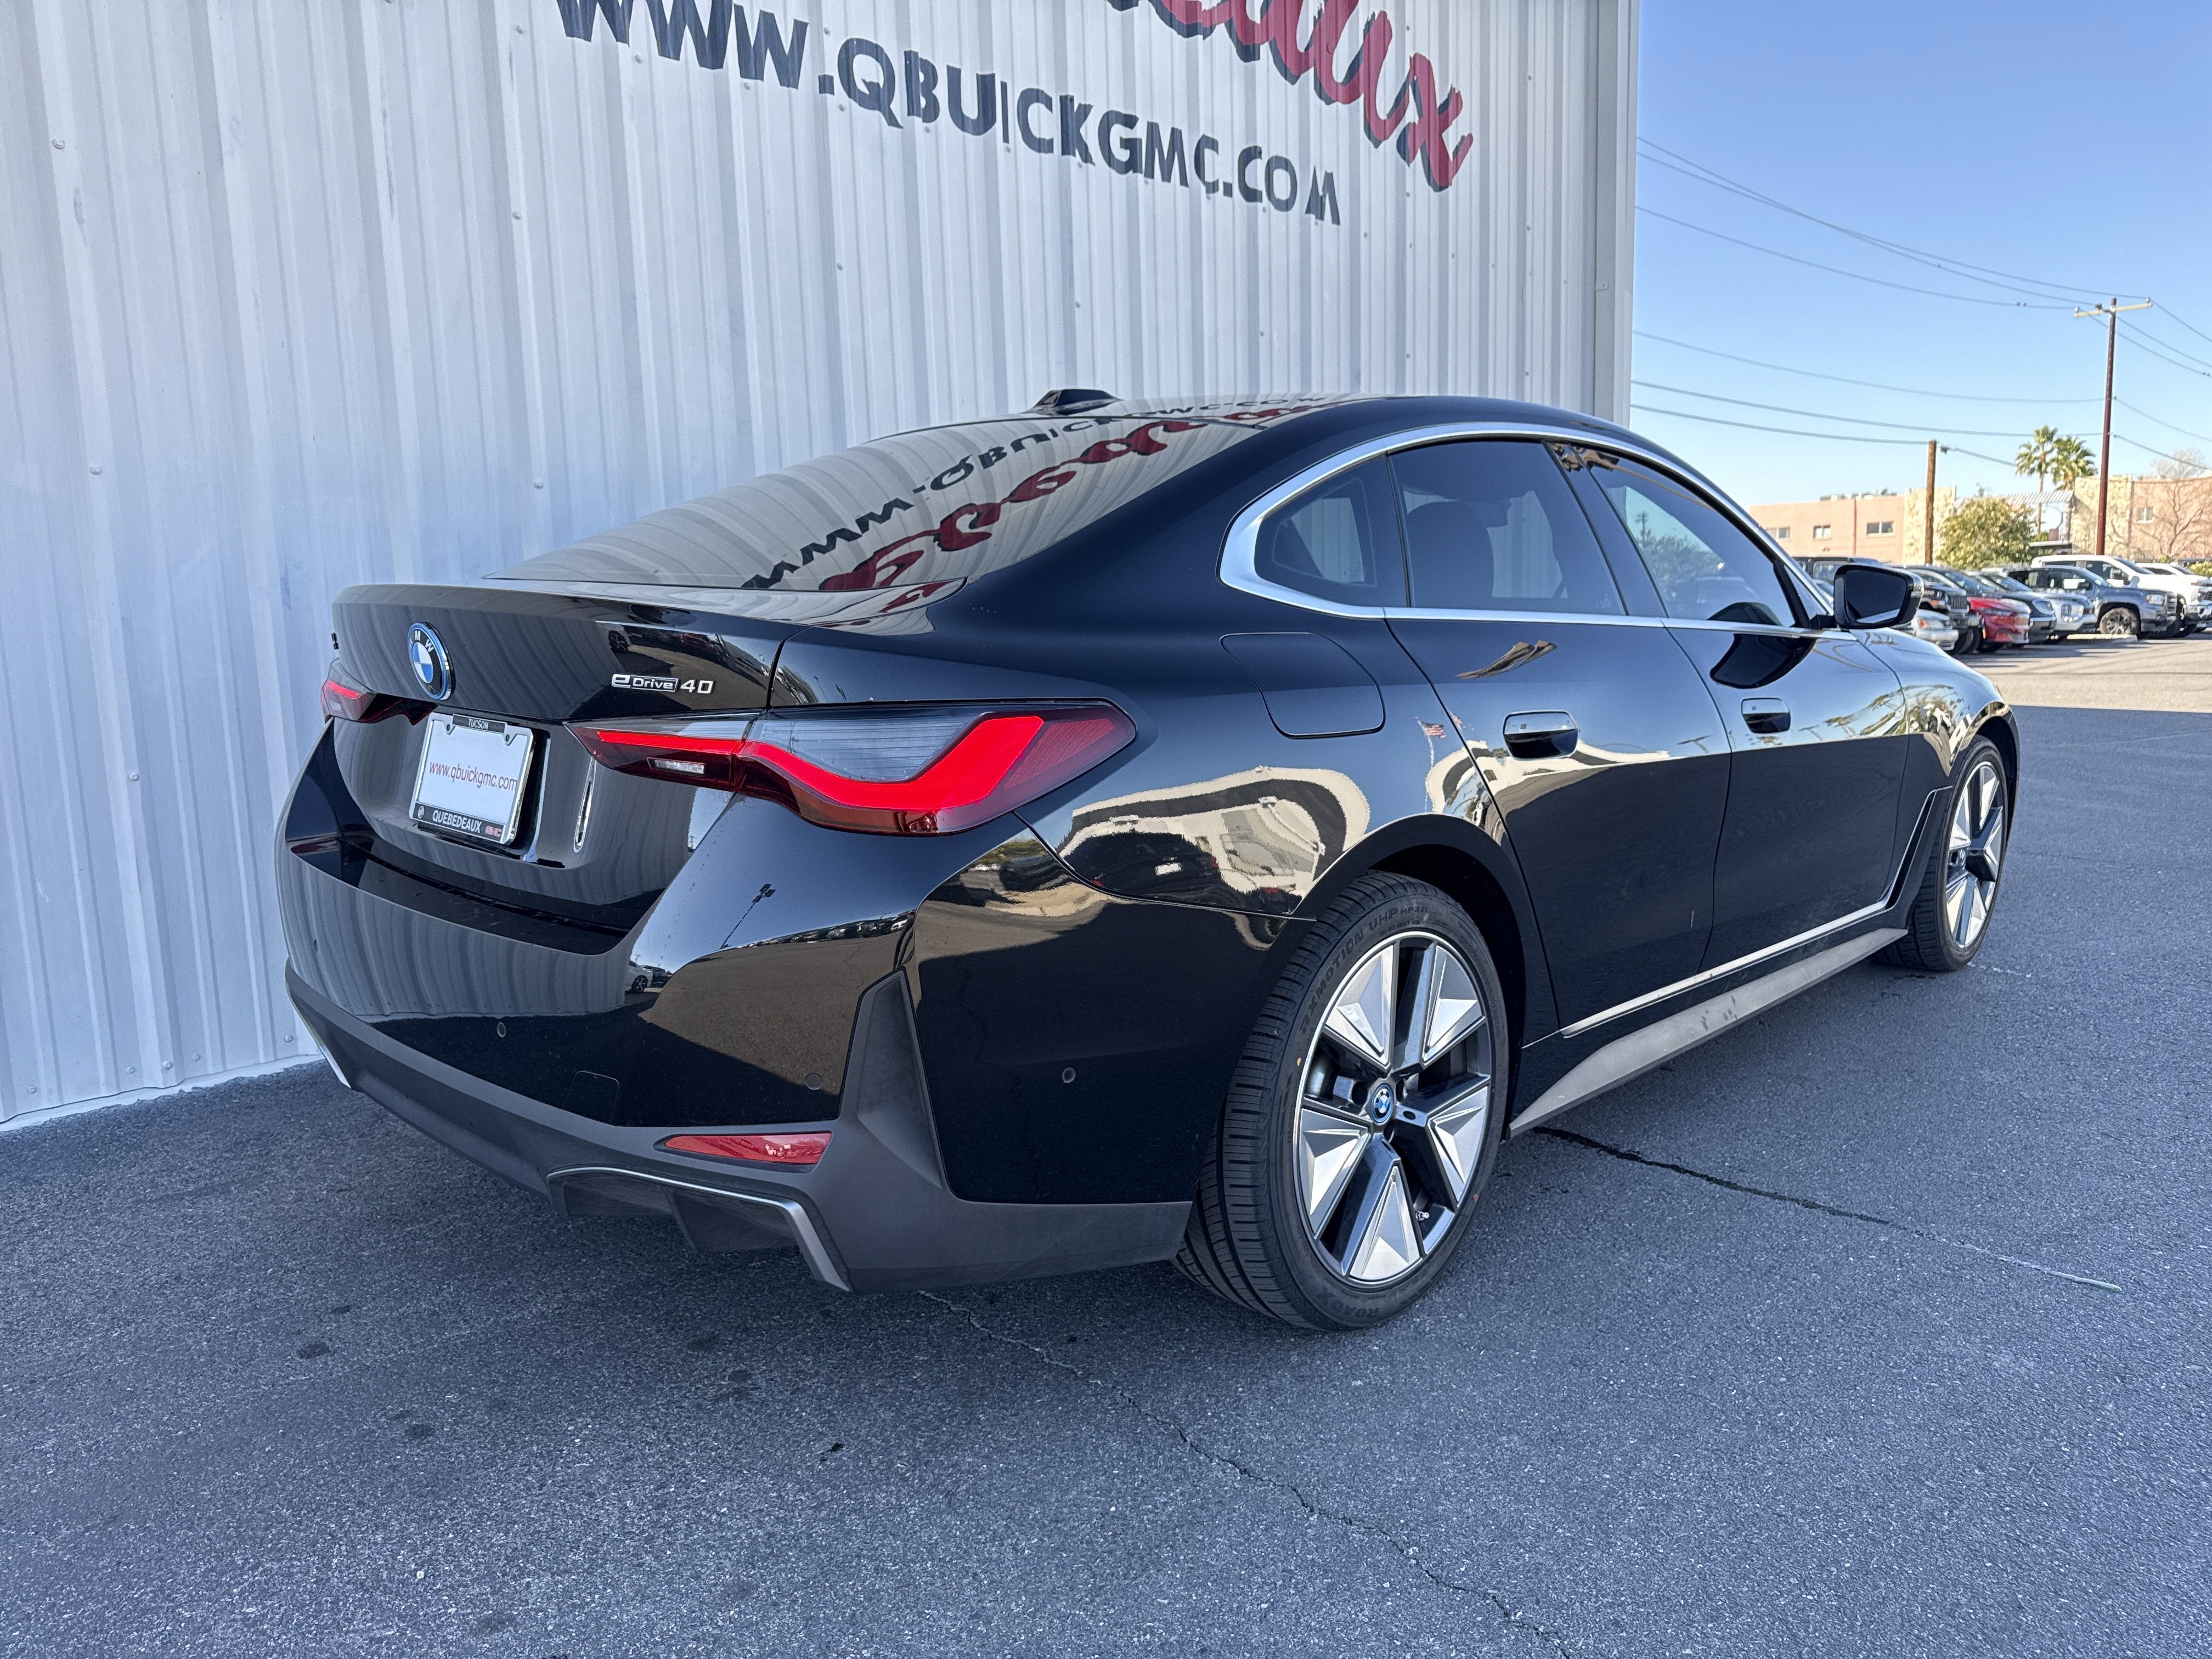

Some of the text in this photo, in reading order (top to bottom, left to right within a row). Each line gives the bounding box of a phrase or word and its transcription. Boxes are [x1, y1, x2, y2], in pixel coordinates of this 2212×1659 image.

[611, 674, 714, 694] eDrive 40
[468, 718, 489, 730] TUCSON
[430, 761, 518, 791] www.qbuickgmc.com
[432, 809, 482, 834] QUEBEDEAUX
[1369, 907, 1398, 931] UHP
